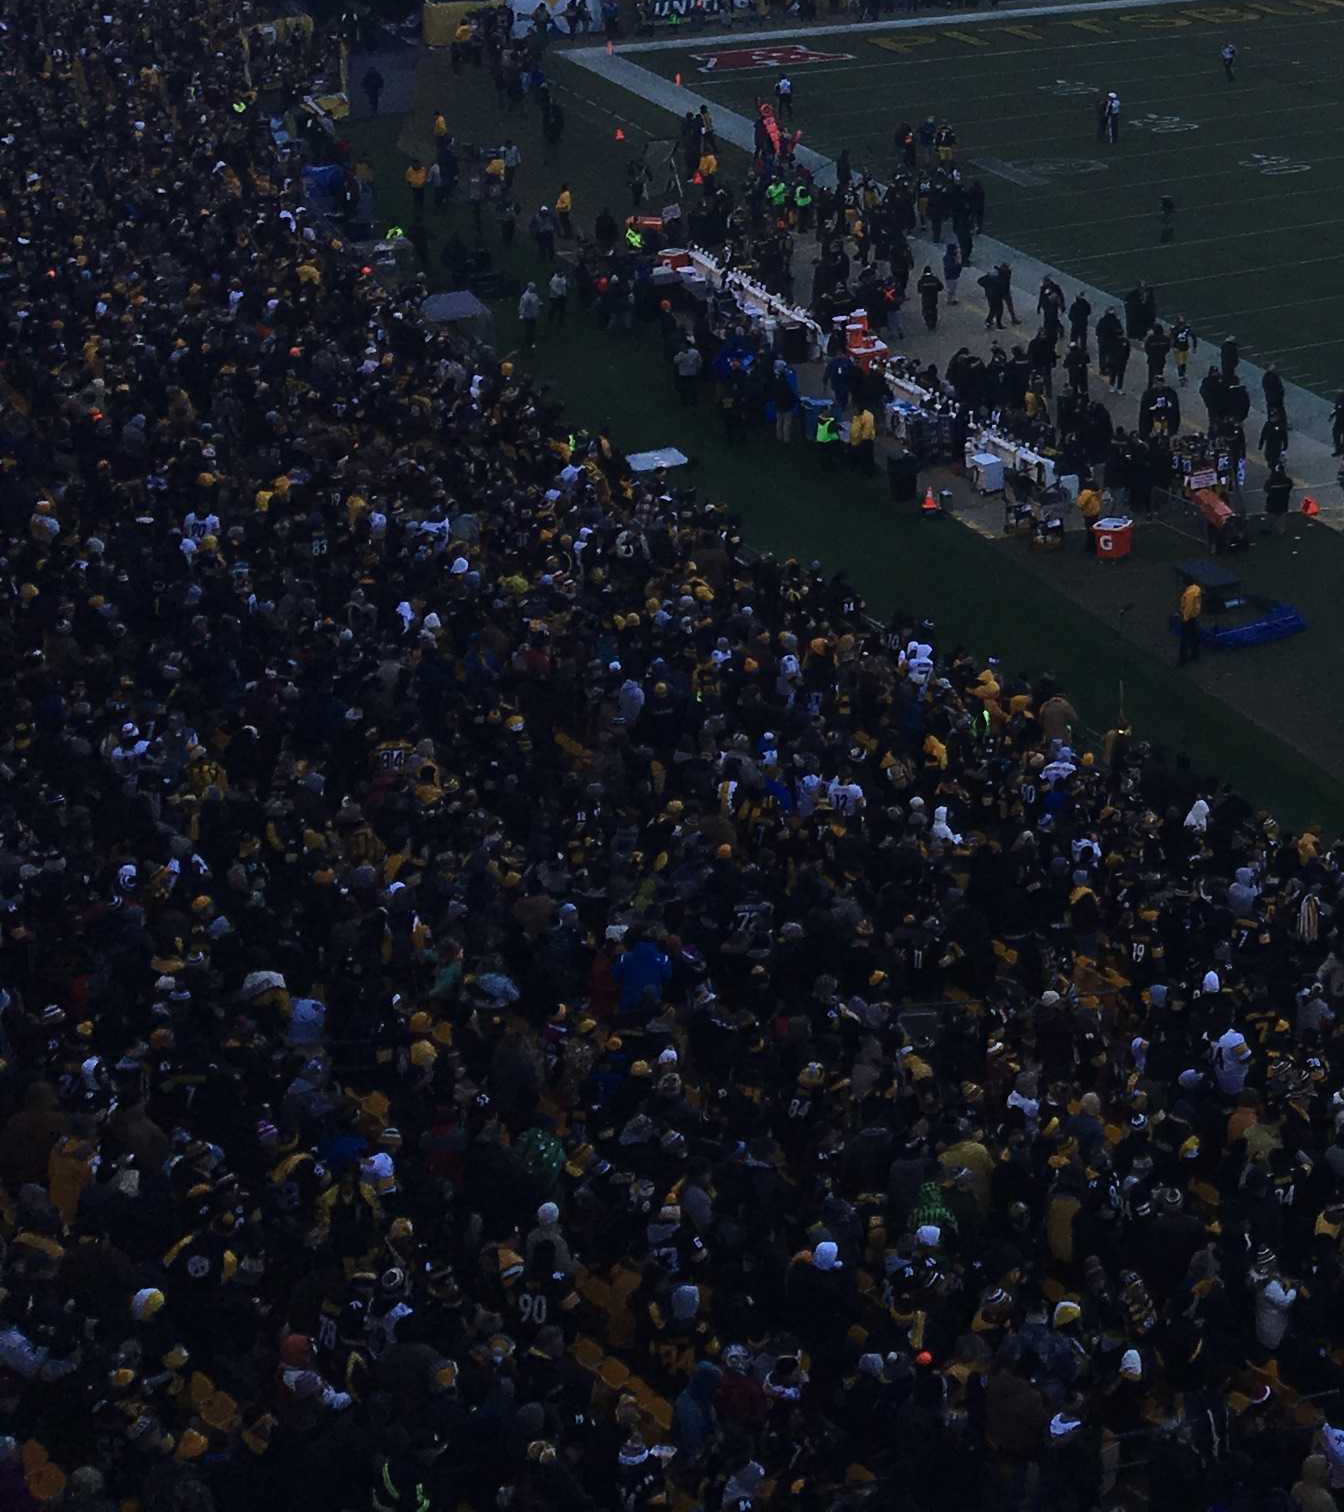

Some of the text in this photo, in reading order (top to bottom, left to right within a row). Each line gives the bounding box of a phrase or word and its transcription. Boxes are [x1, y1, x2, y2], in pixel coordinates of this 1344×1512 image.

[1100, 535, 1113, 551] G
[1132, 942, 1145, 964] 19
[518, 1293, 547, 1324] 90
